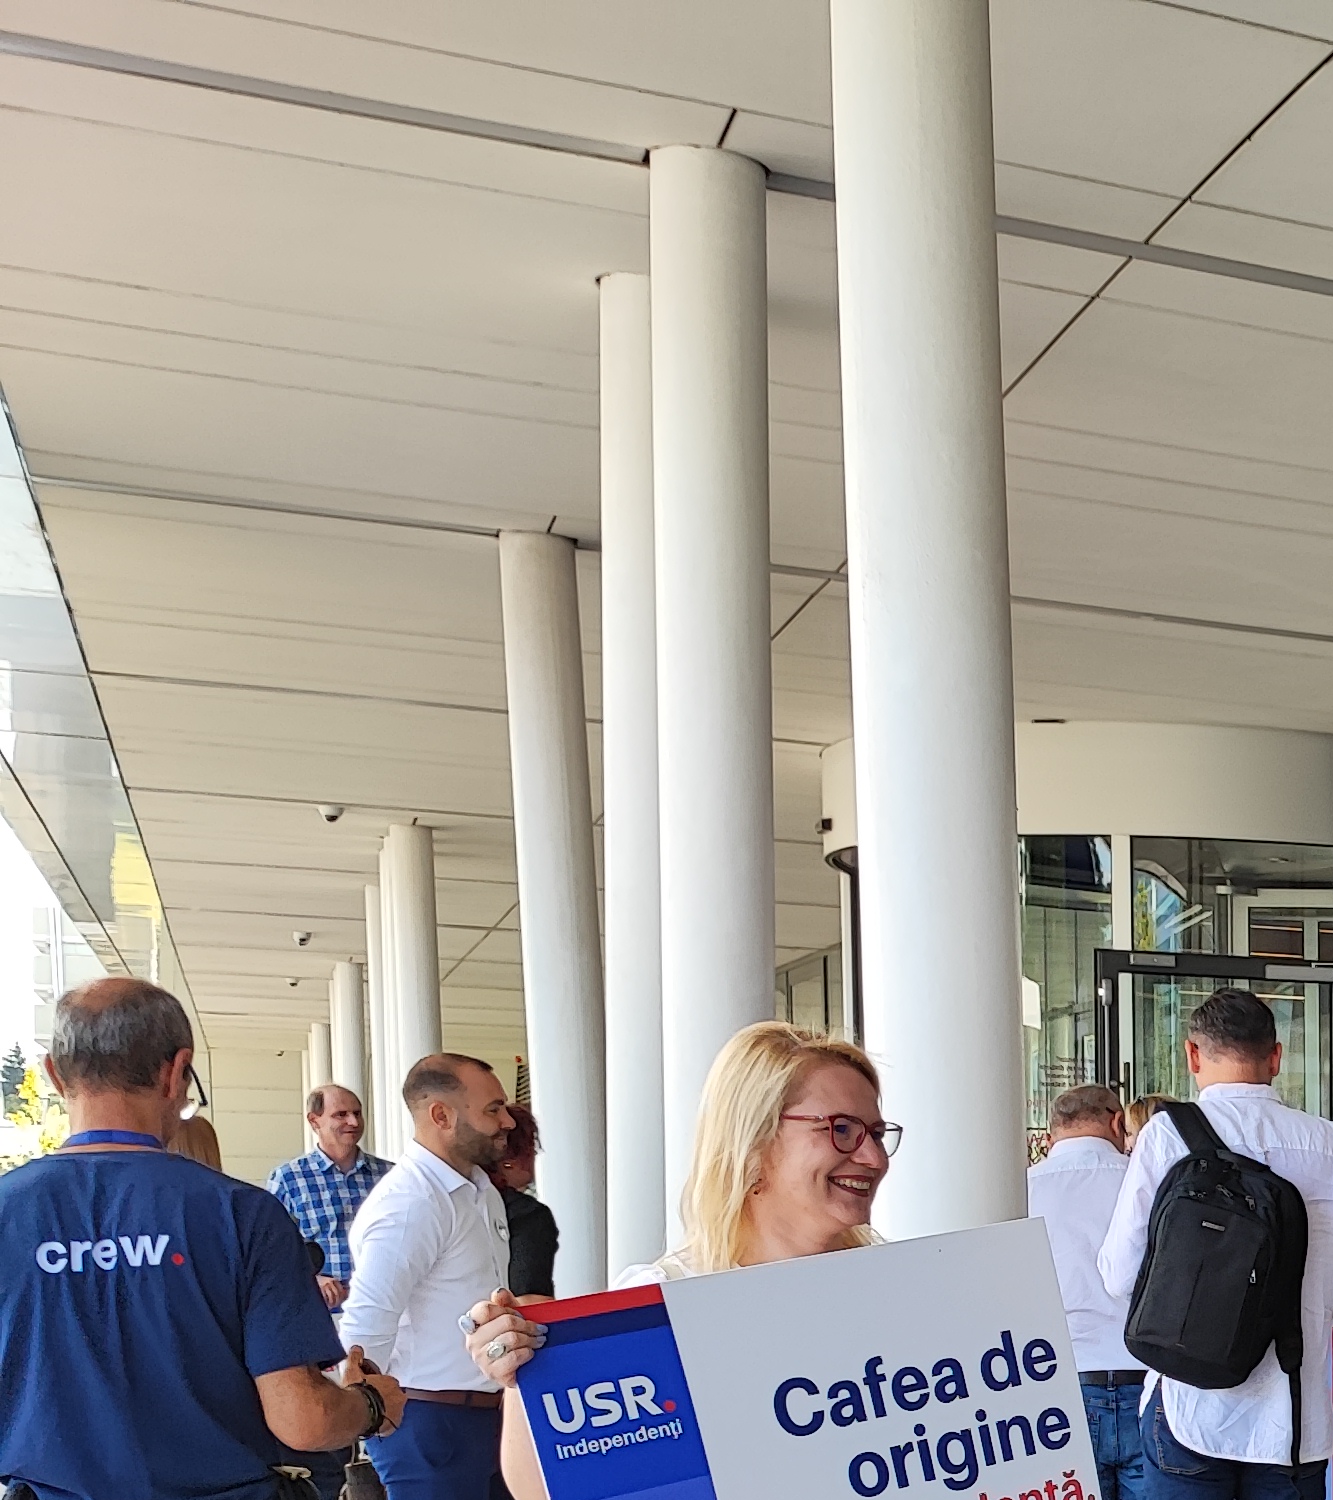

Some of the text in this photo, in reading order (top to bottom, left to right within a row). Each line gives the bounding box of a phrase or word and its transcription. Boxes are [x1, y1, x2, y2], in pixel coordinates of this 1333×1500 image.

[36, 1235, 184, 1273] crew.
[542, 1375, 676, 1433] USR.
[773, 1329, 1058, 1437] Cafea de
[848, 1406, 1071, 1498] origine
